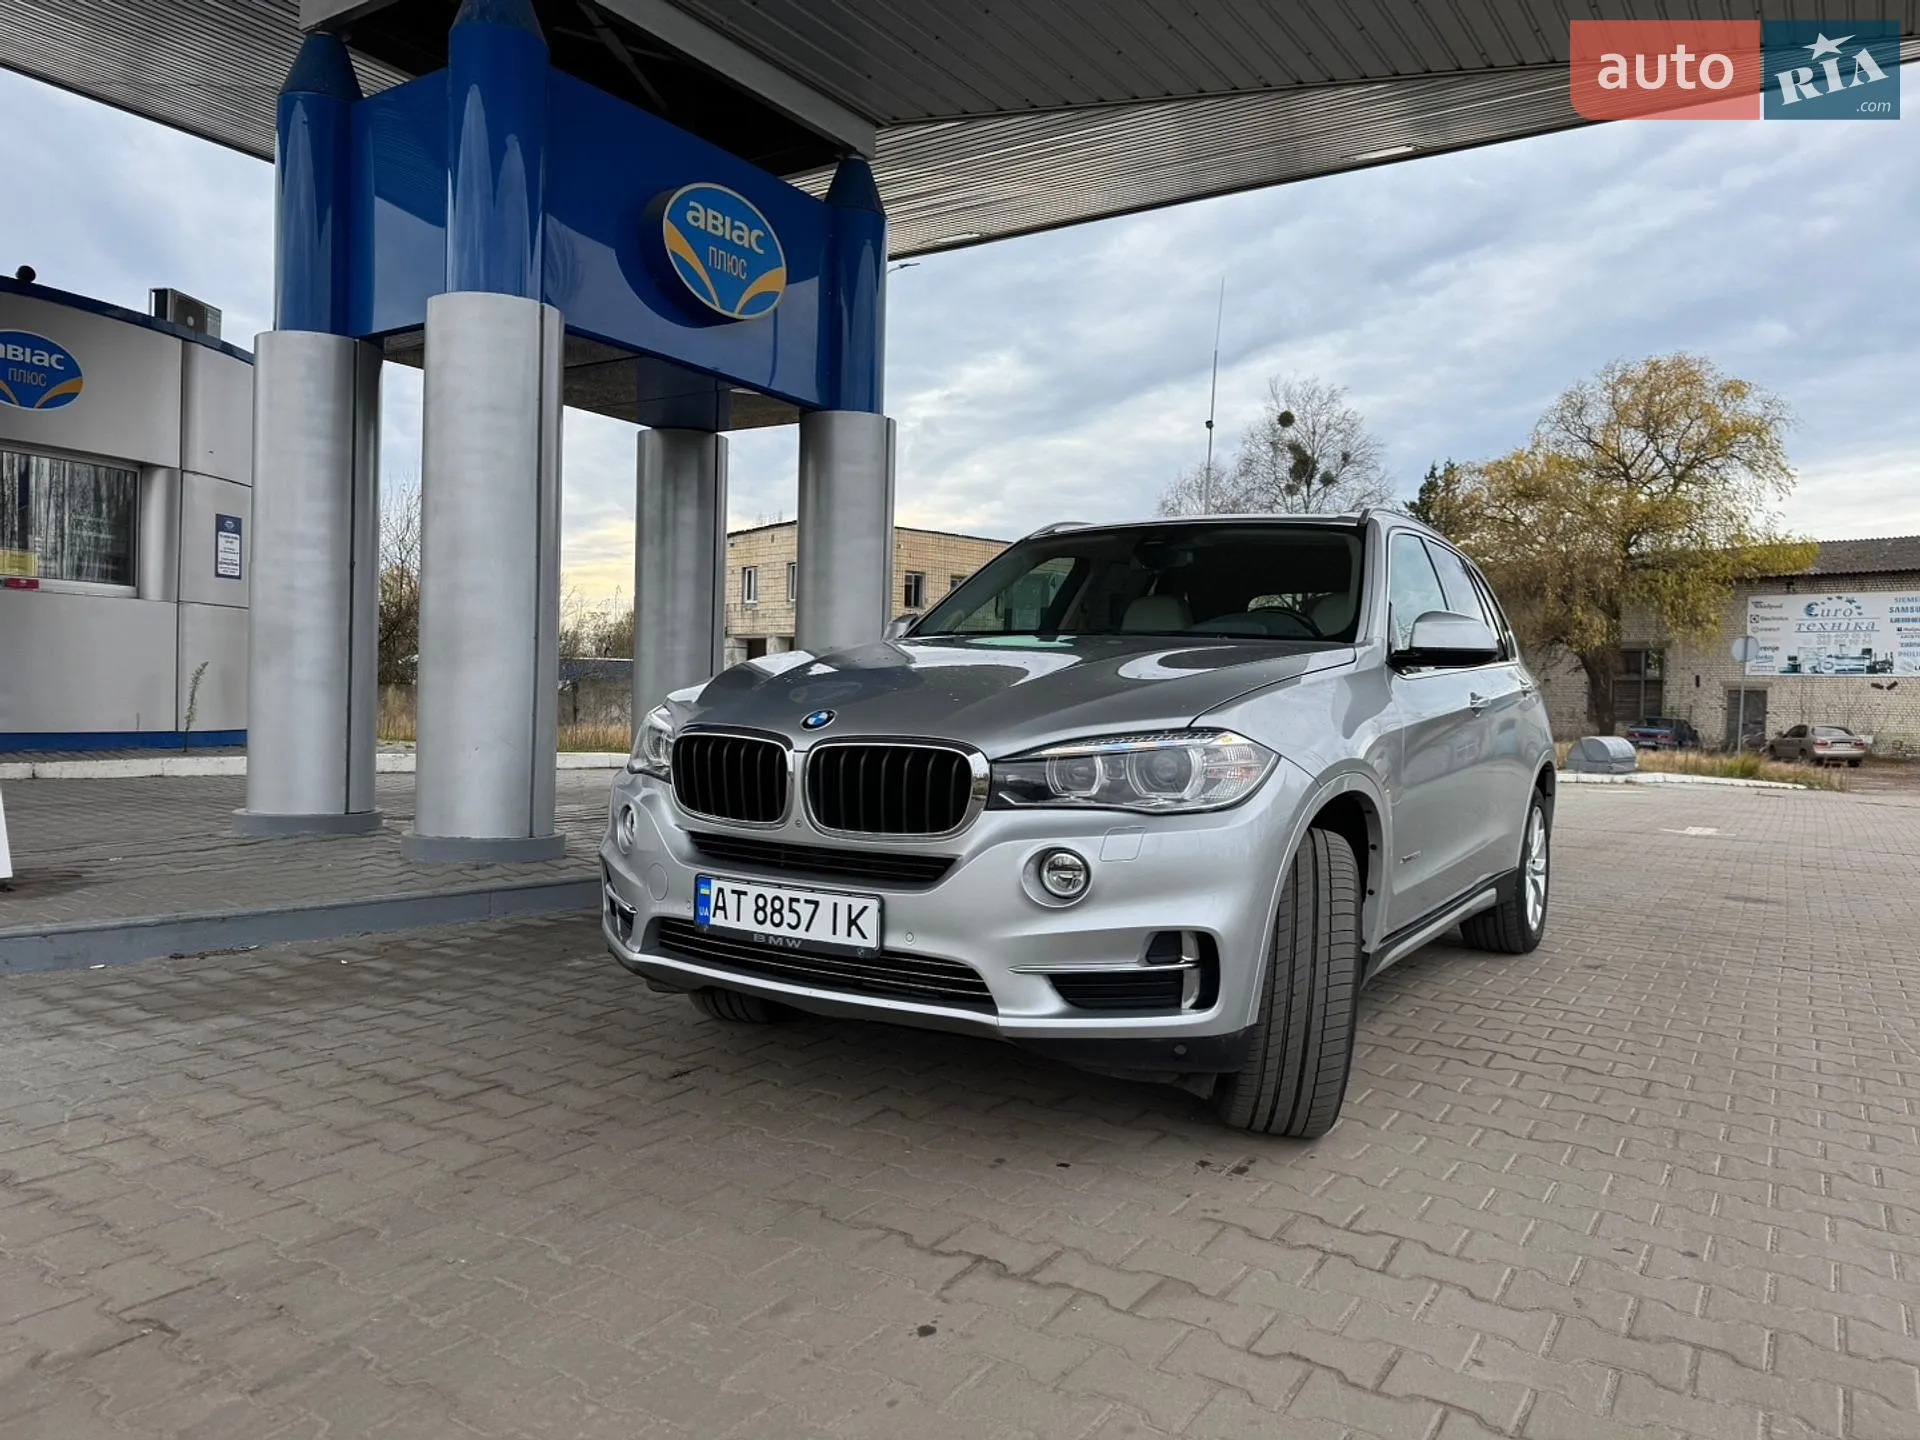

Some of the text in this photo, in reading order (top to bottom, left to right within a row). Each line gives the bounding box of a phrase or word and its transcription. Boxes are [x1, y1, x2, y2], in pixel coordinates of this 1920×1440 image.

[712, 887, 868, 939] AT 8857 IK
[752, 933, 803, 949] BMW
